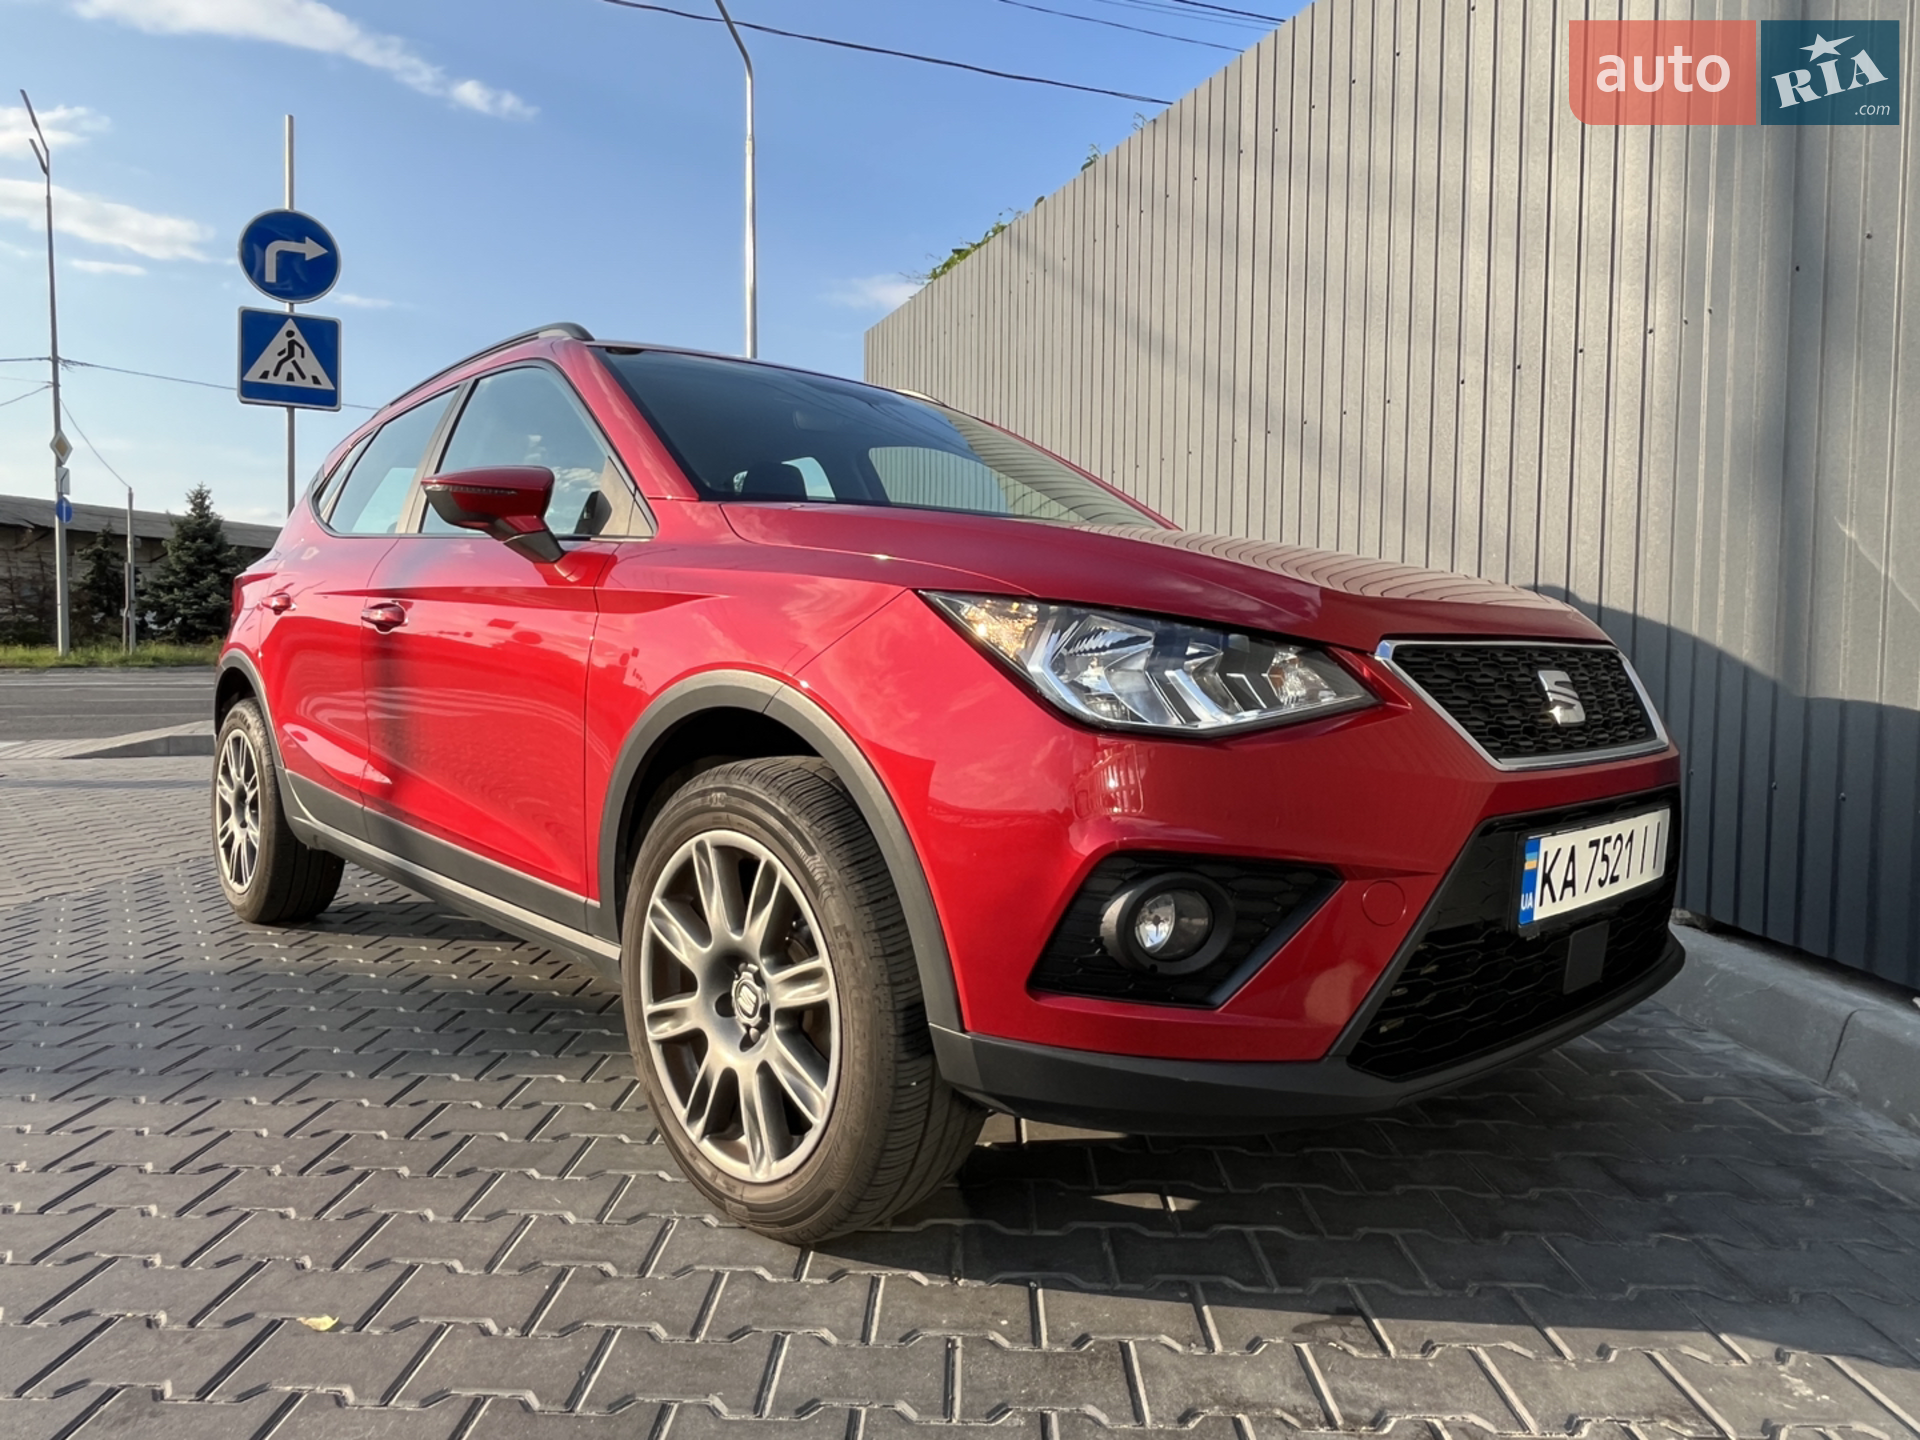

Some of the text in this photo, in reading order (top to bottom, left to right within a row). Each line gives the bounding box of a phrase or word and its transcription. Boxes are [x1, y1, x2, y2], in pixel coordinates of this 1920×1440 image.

[1538, 844, 1577, 907] KA
[1584, 828, 1635, 893] 7521
[1521, 892, 1533, 911] UA
